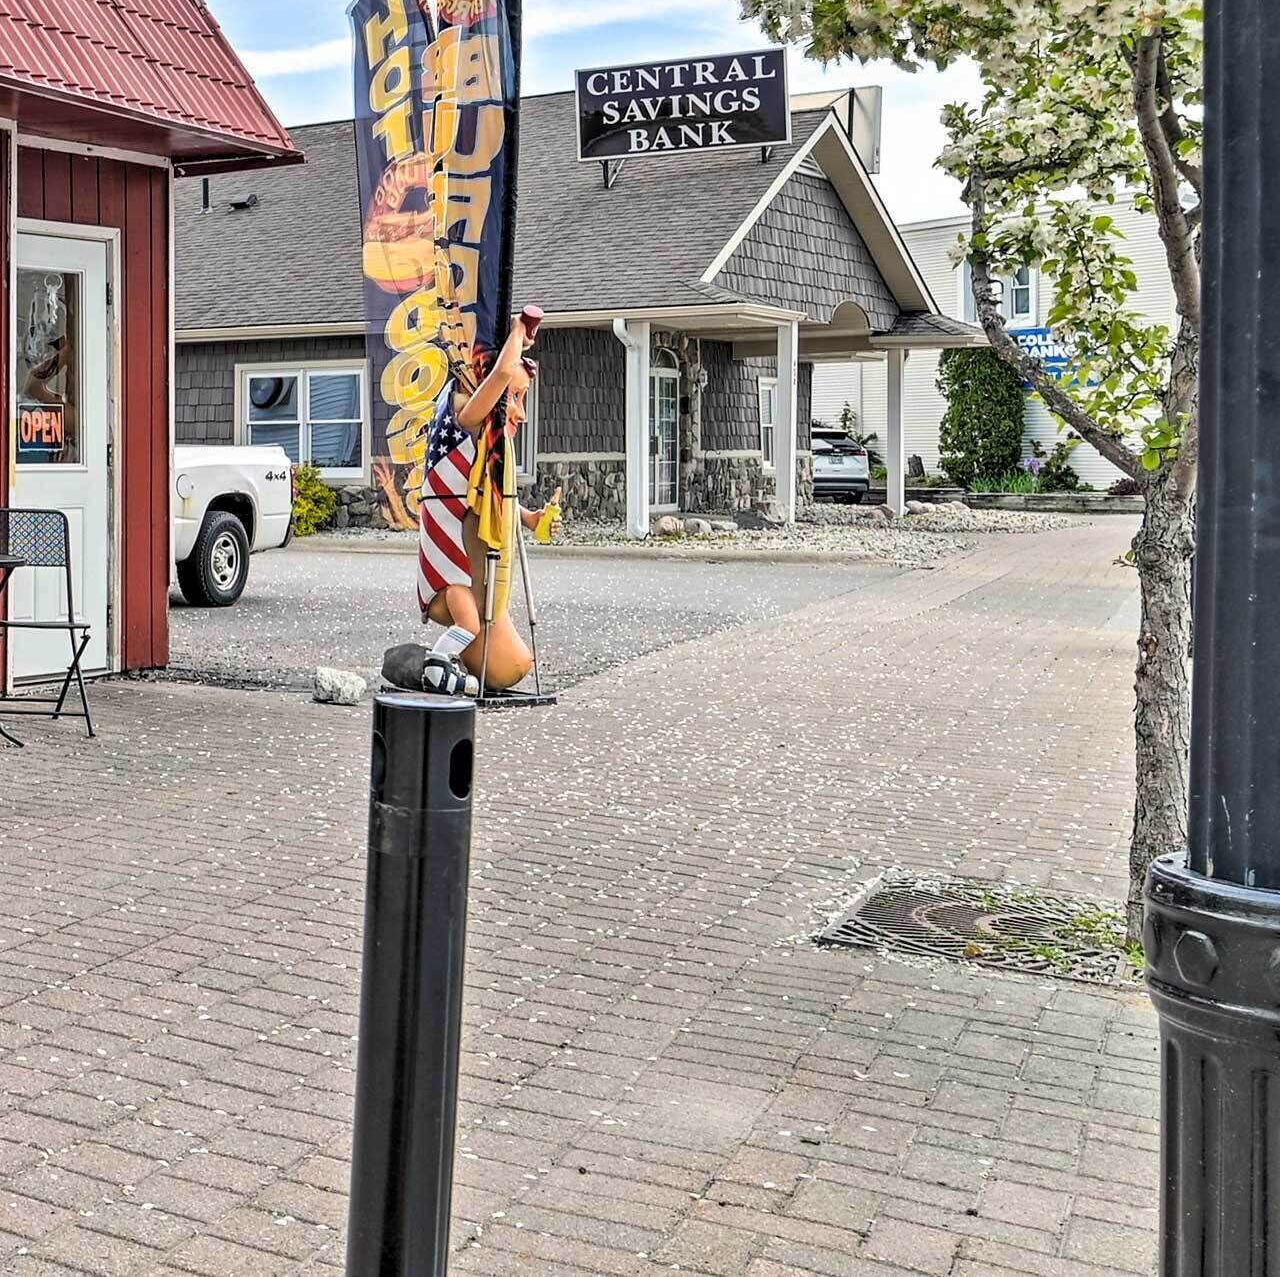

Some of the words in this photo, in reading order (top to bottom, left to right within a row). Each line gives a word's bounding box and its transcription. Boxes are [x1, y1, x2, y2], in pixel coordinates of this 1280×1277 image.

[586, 55, 776, 96] CENTRAL
[602, 87, 761, 125] SAVINGS
[627, 121, 737, 153] BANK
[21, 410, 61, 443] OPEN
[265, 471, 287, 481] 4x4
